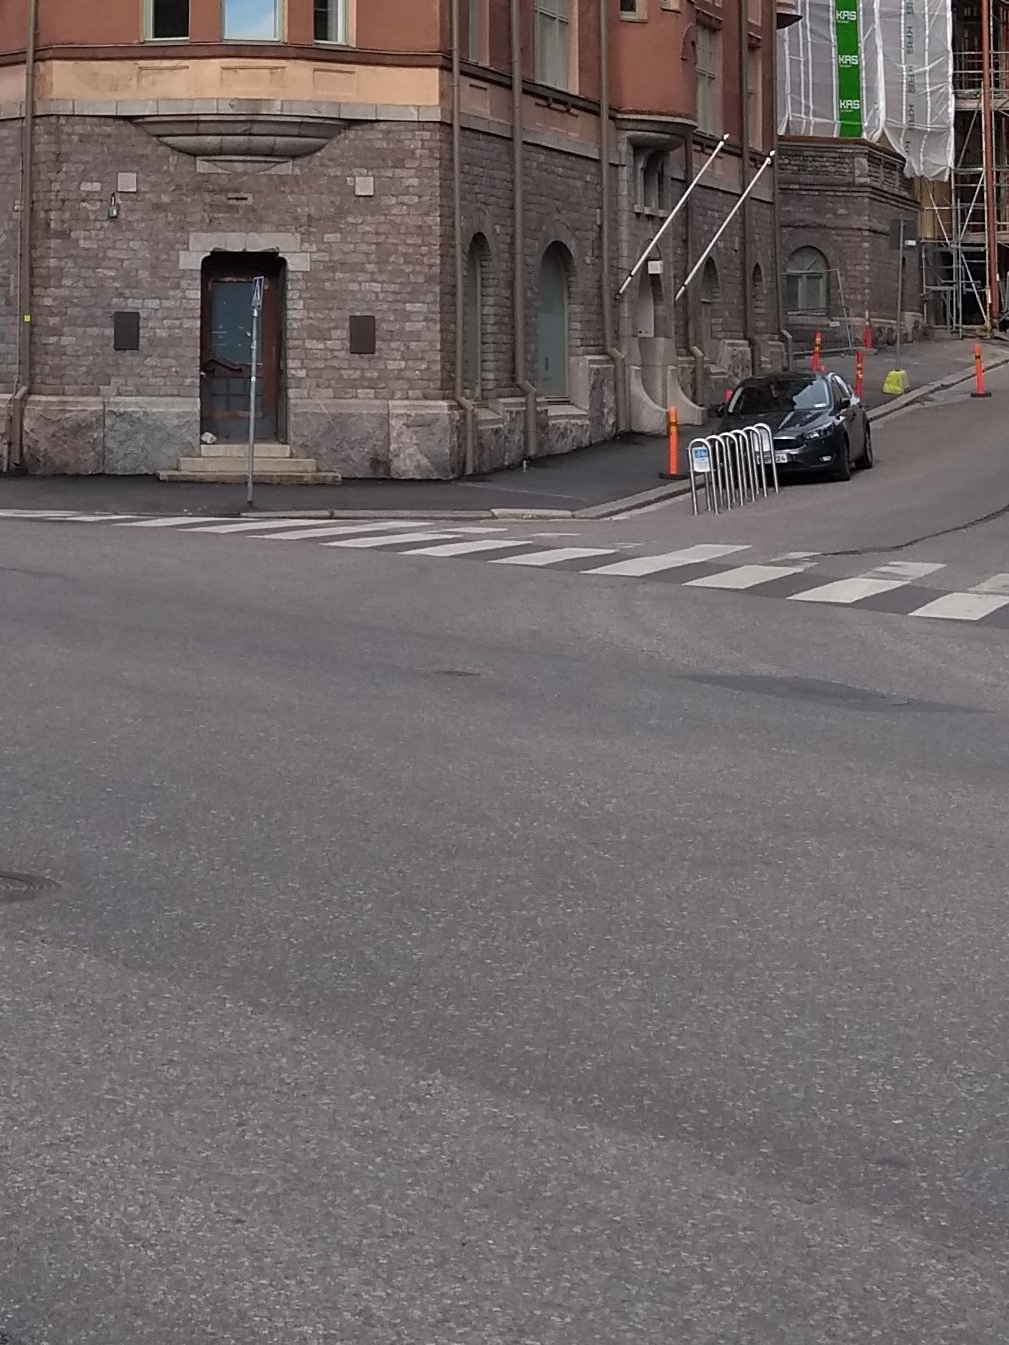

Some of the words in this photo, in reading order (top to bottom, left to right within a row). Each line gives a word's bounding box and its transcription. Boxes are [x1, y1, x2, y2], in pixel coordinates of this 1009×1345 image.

[836, 11, 856, 21] KAS
[838, 55, 858, 65] KAS
[840, 100, 860, 109] KAS
